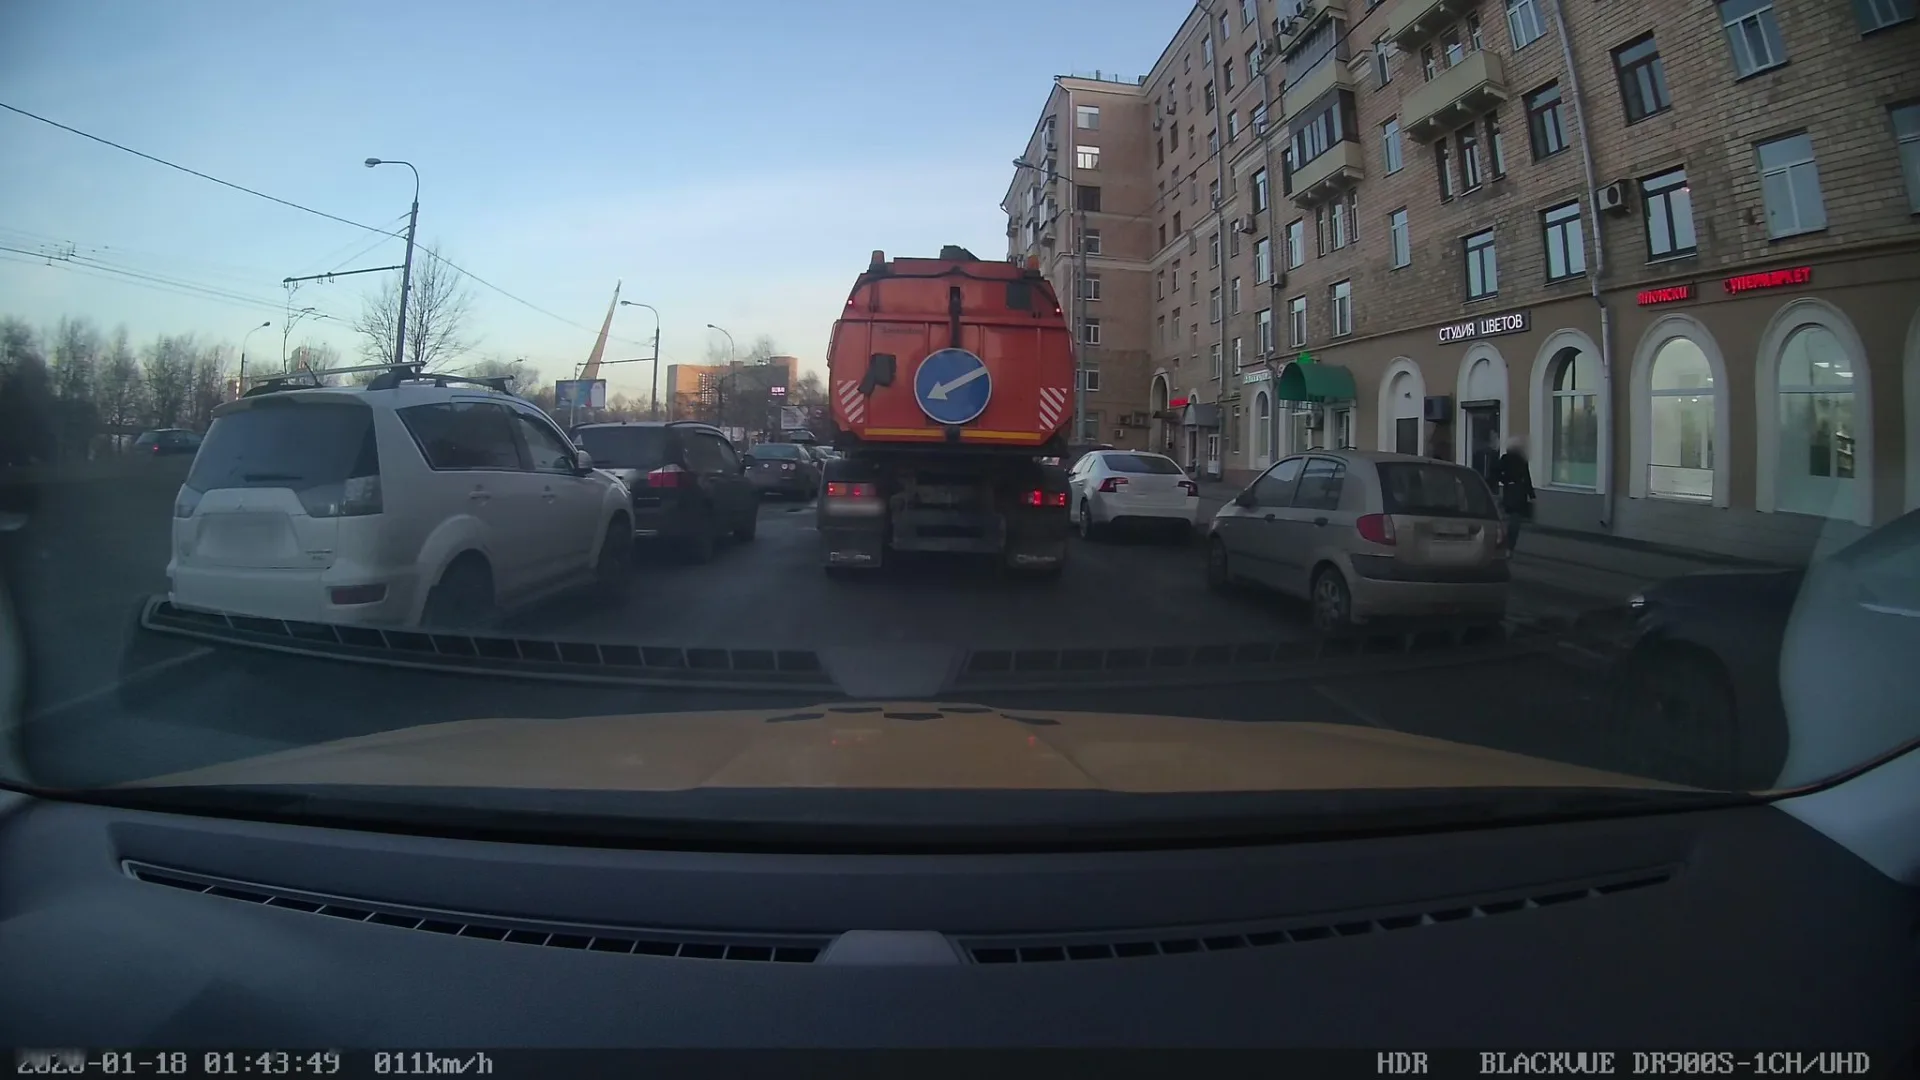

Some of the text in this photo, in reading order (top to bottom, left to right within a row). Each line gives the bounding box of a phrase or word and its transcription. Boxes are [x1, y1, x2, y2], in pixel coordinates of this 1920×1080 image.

[1637, 285, 1695, 304] ЯПОНСКИ
[1439, 314, 1523, 341] СТУДИЯ ЦВЕТОВ
